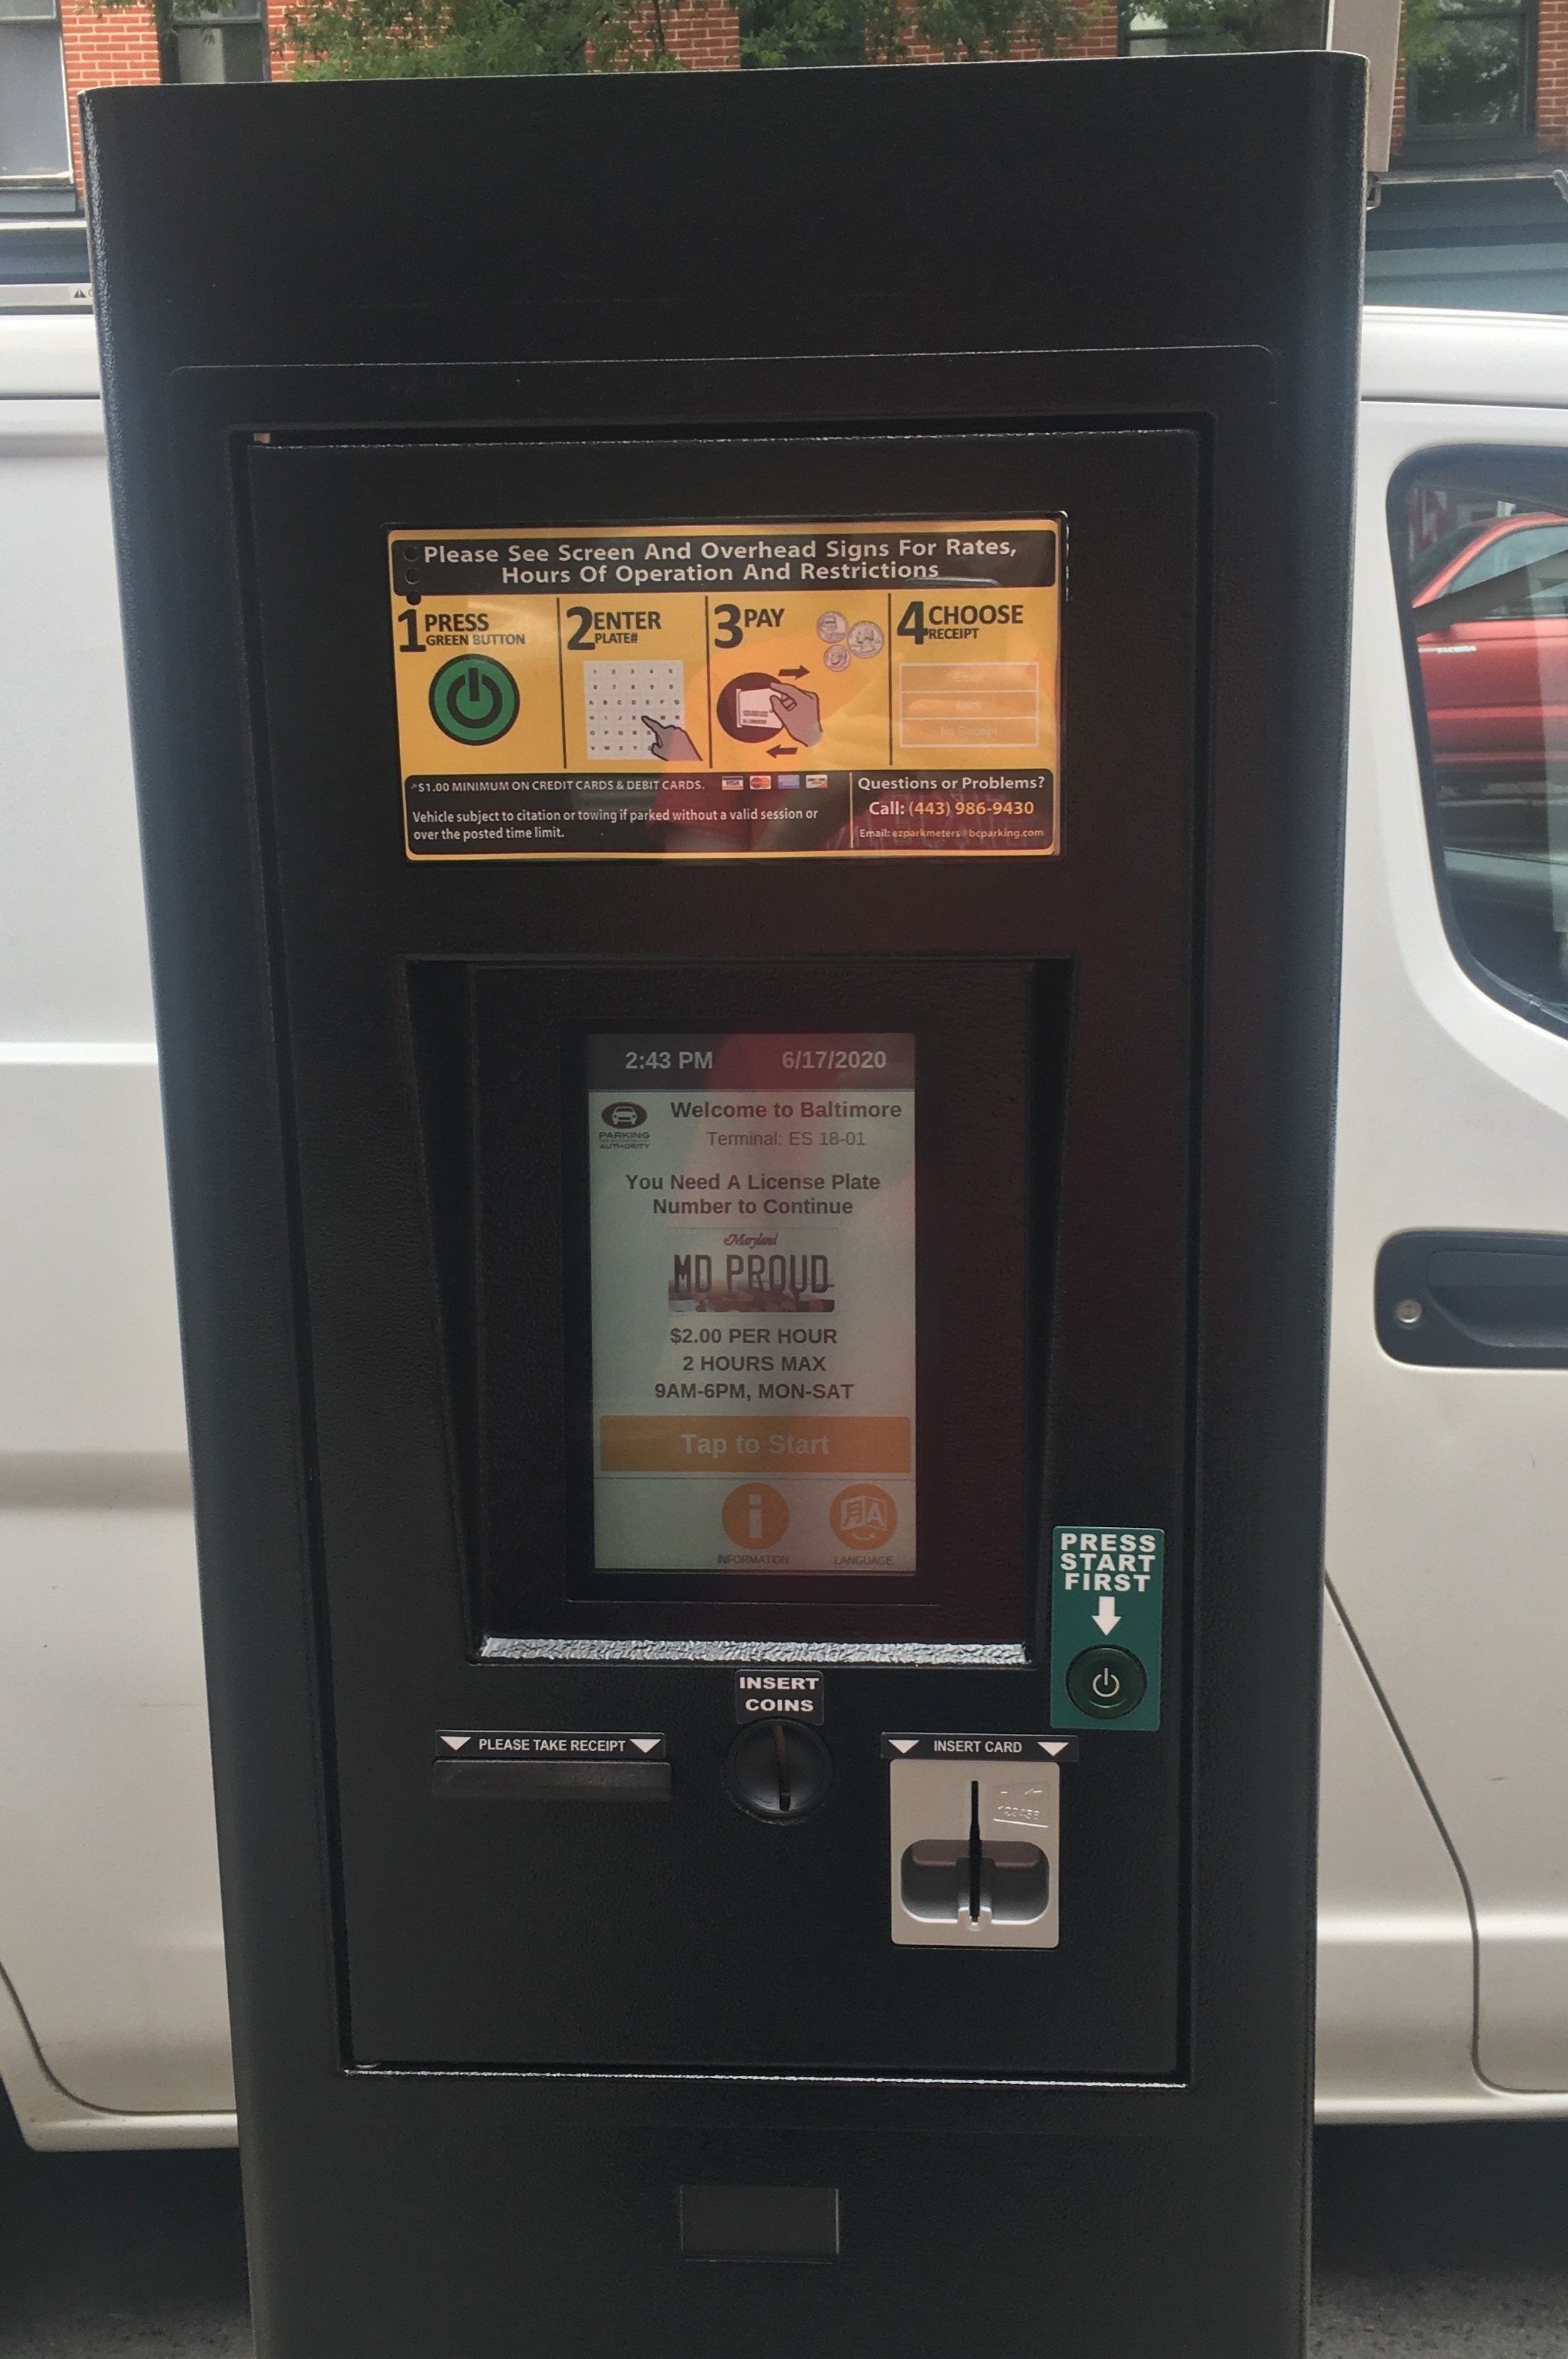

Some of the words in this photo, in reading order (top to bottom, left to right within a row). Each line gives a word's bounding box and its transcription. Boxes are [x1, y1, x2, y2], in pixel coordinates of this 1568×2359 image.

[424, 545, 499, 564] Please
[508, 545, 549, 562] See
[559, 544, 635, 562] Screen
[645, 542, 691, 561] And
[702, 540, 816, 559] Overhead
[827, 540, 890, 561] Signs
[899, 540, 937, 557] For
[946, 538, 1016, 557] Rates,
[502, 566, 571, 584] Hours
[580, 565, 607, 582] Of
[616, 564, 733, 586] Operation
[743, 563, 790, 581] And
[801, 561, 939, 579] Restrictions
[398, 609, 426, 653] 1
[425, 613, 489, 632] PRESS
[566, 606, 596, 651] 2
[594, 611, 662, 631] ENTER
[714, 604, 743, 648] 3
[744, 609, 785, 628] PAY
[896, 601, 928, 646] 4
[928, 605, 1024, 625] CHOOSE
[426, 635, 468, 646] GREEN
[473, 633, 526, 646] BUTTON
[595, 633, 638, 644] PLATE#
[928, 628, 979, 640] RECEIPT
[452, 781, 510, 791] MINIMUM
[512, 781, 530, 791] ON
[532, 781, 573, 791] CREDIT
[575, 780, 614, 790] CARDS
[616, 781, 625, 790] &
[626, 780, 659, 790] DEBIT
[662, 780, 705, 790] CARDS.
[857, 777, 938, 790] Questions
[941, 780, 958, 789] or
[962, 776, 1046, 789] Problems?
[412, 811, 455, 823] Vehicle
[457, 810, 500, 825] subject
[502, 811, 514, 822] to
[516, 810, 561, 821] citation
[563, 812, 576, 820] or
[578, 810, 617, 823] towing
[620, 808, 628, 820] if
[630, 808, 670, 822] parked
[672, 808, 717, 820] without
[719, 811, 726, 820] a
[729, 808, 758, 820] valid
[761, 808, 803, 820] session
[805, 811, 818, 819] or
[869, 801, 905, 815] Call:
[909, 801, 950, 817] (443)
[955, 801, 1035, 815] 986-9430
[414, 830, 439, 840] over
[441, 828, 461, 839] the
[463, 828, 503, 842] posted
[505, 827, 532, 838] time
[535, 826, 565, 838] limit.
[859, 828, 890, 838] Email:
[625, 1052, 671, 1069] 2:43
[679, 1052, 714, 1069] PM
[782, 1051, 886, 1069] 6/17/2020
[670, 1101, 767, 1118] Welcome
[774, 1103, 793, 1118] to
[800, 1101, 902, 1118] Baltimore
[707, 1131, 782, 1146] Terminal:
[789, 1131, 813, 1146] ES
[819, 1131, 866, 1146] 18-01
[626, 1175, 663, 1190] You
[670, 1174, 720, 1190] Need
[727, 1175, 741, 1189] A
[748, 1173, 825, 1190] License
[832, 1173, 881, 1190] Plate
[653, 1198, 731, 1214] Number
[739, 1199, 757, 1214] to
[763, 1198, 853, 1214] Continue
[724, 1233, 779, 1249] Maryland
[673, 1253, 712, 1293] MD
[726, 1254, 829, 1294] PROUD
[670, 1327, 721, 1346] $2.00
[729, 1328, 770, 1344] PER
[778, 1328, 837, 1344] HOUR
[682, 1357, 694, 1371] 2
[701, 1356, 775, 1371] HOURS
[781, 1356, 827, 1371] MAX
[654, 1383, 751, 1401] 9AM-6PM,
[758, 1384, 855, 1399] MON-SAT
[681, 1433, 727, 1458] Tap
[736, 1435, 760, 1454] to
[768, 1434, 829, 1455] Start
[1060, 1533, 1156, 1552] PRESS
[717, 1555, 789, 1565] INFORMATION
[834, 1556, 893, 1565] LANGUAGE
[1060, 1553, 1156, 1573] START
[1064, 1573, 1151, 1592] FIRST
[739, 1676, 819, 1691] INSERT
[745, 1699, 815, 1712] COINS
[478, 1738, 530, 1751] PLEASE
[533, 1739, 567, 1752] TAKE
[570, 1739, 626, 1753] RECEIPT
[934, 1740, 982, 1753] INSERT
[984, 1740, 1023, 1753] CARD
